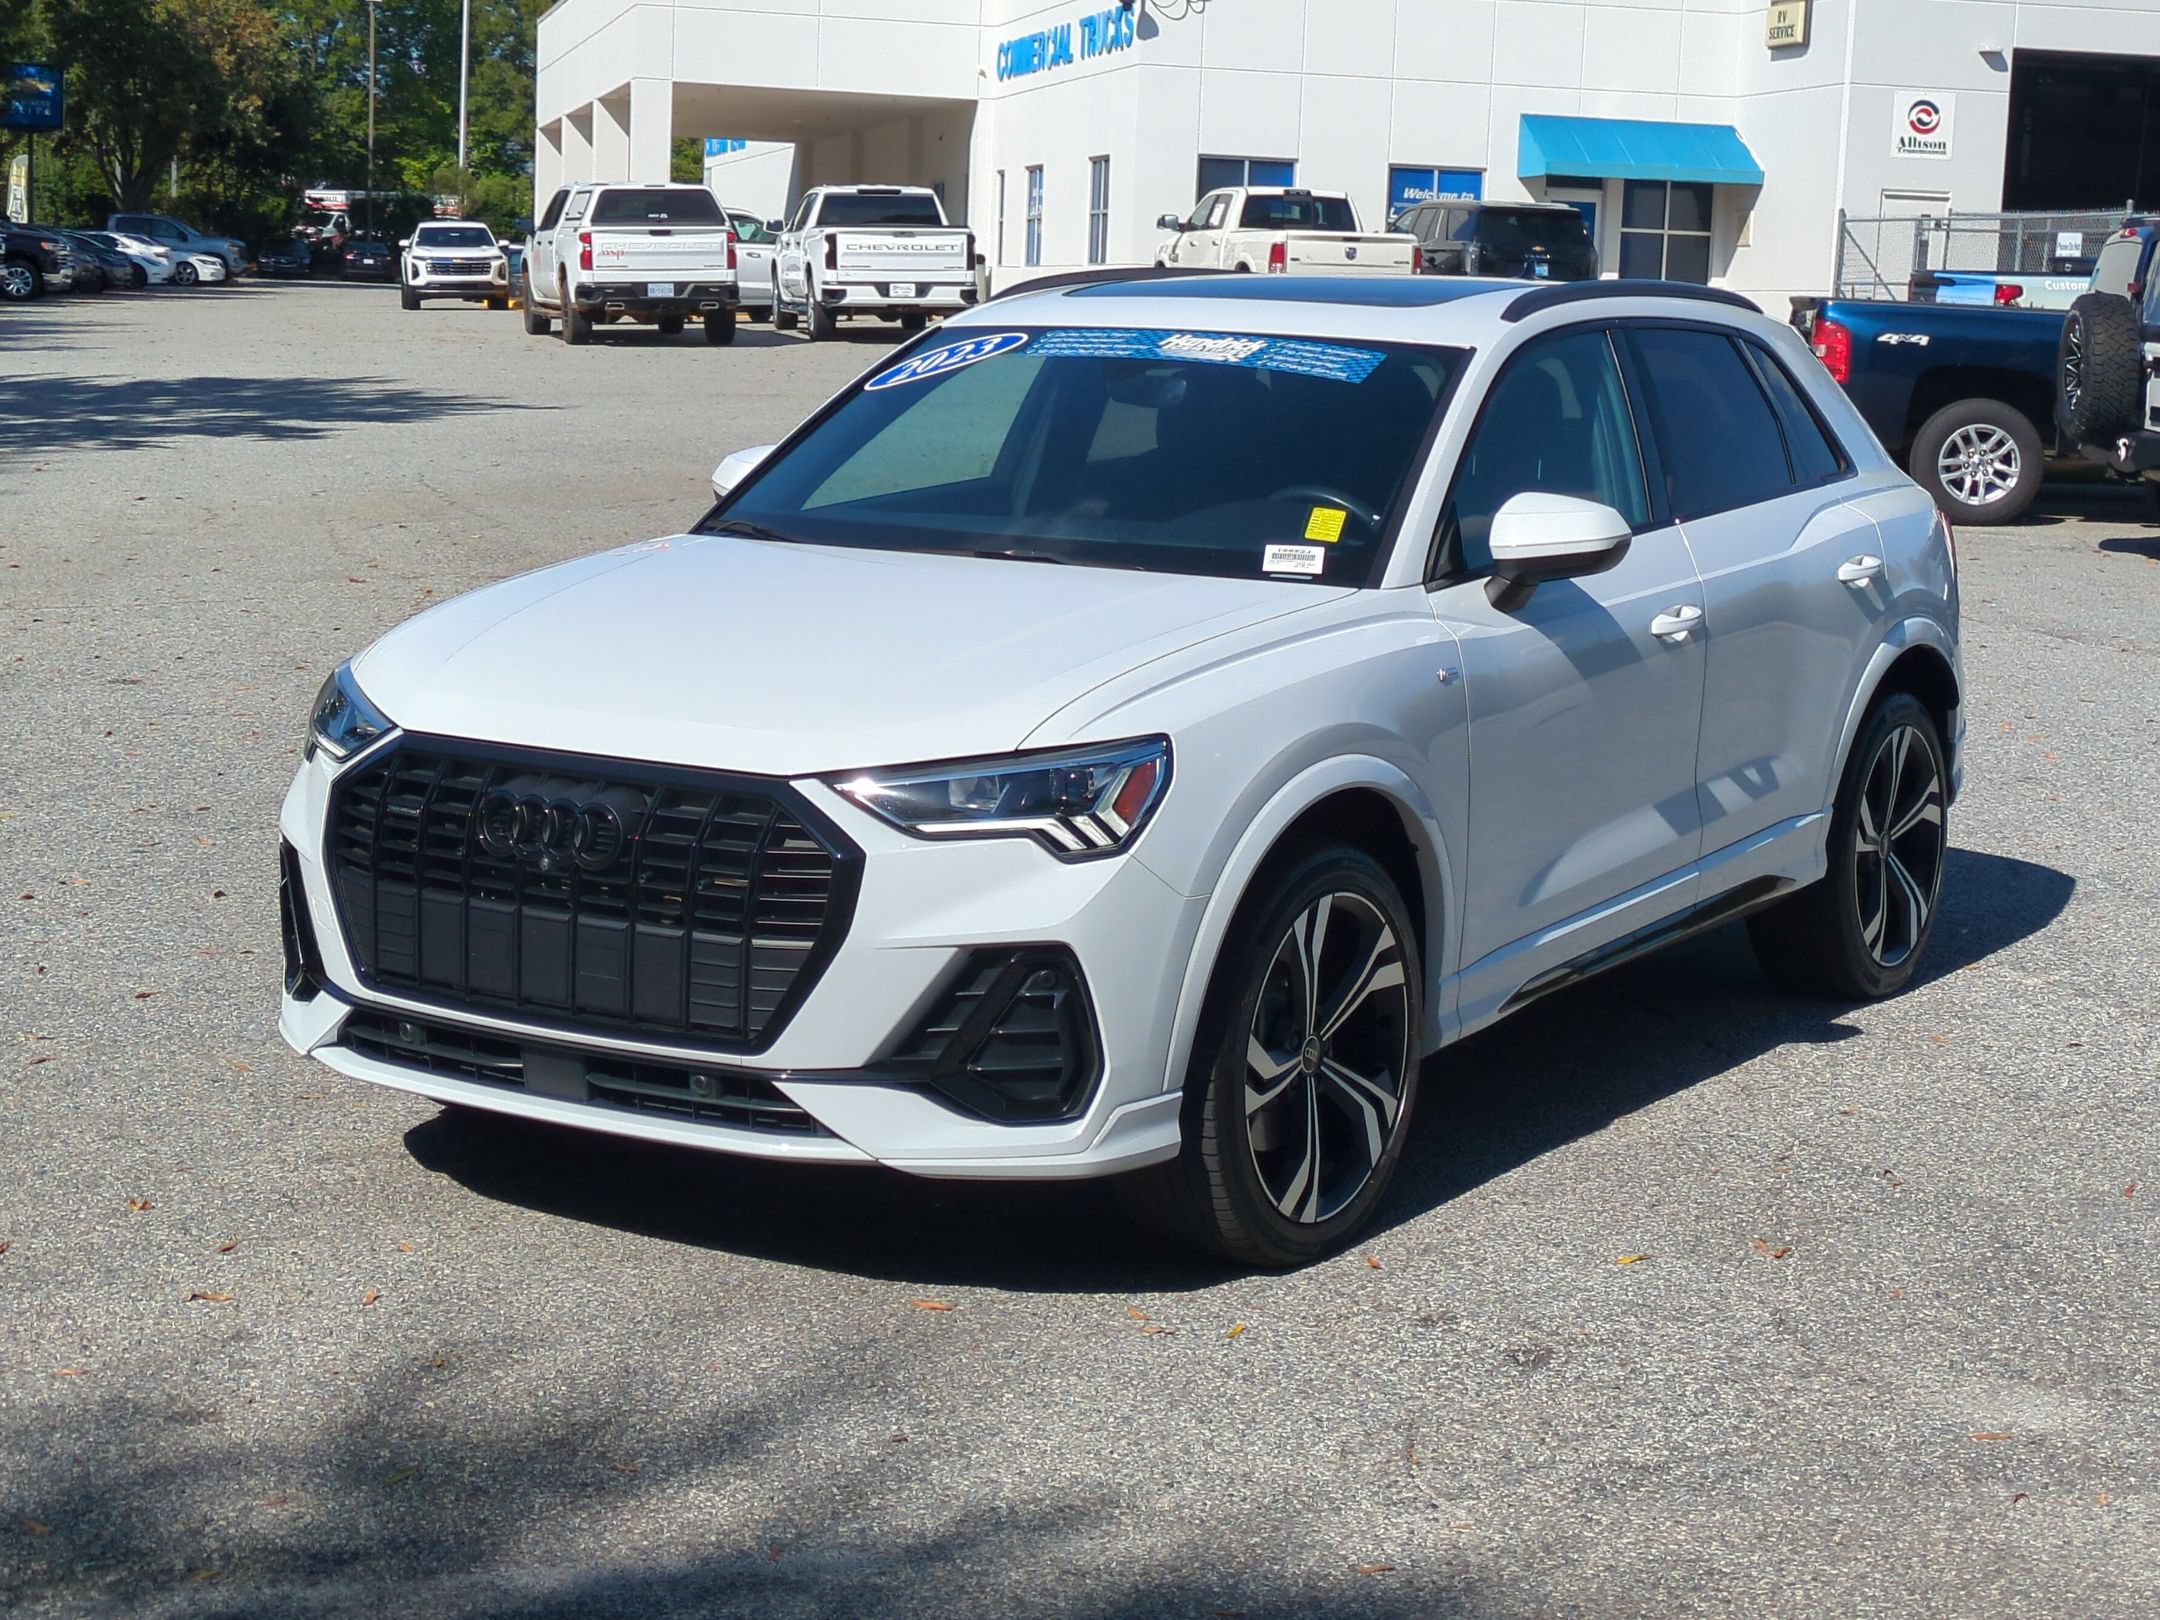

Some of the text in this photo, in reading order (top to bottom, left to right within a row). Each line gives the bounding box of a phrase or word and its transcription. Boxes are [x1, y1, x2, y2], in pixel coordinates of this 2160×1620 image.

[1777, 10, 1788, 24] RV
[1768, 24, 1796, 40] SERVICE
[997, 4, 1135, 82] COMMERCIAL TRUCKS
[1897, 135, 1946, 150] Allison
[1403, 187, 1459, 201] Welcme
[846, 243, 960, 252] CHEVROLET
[1158, 334, 1268, 357] Hendrick
[886, 336, 1003, 384] 2023
